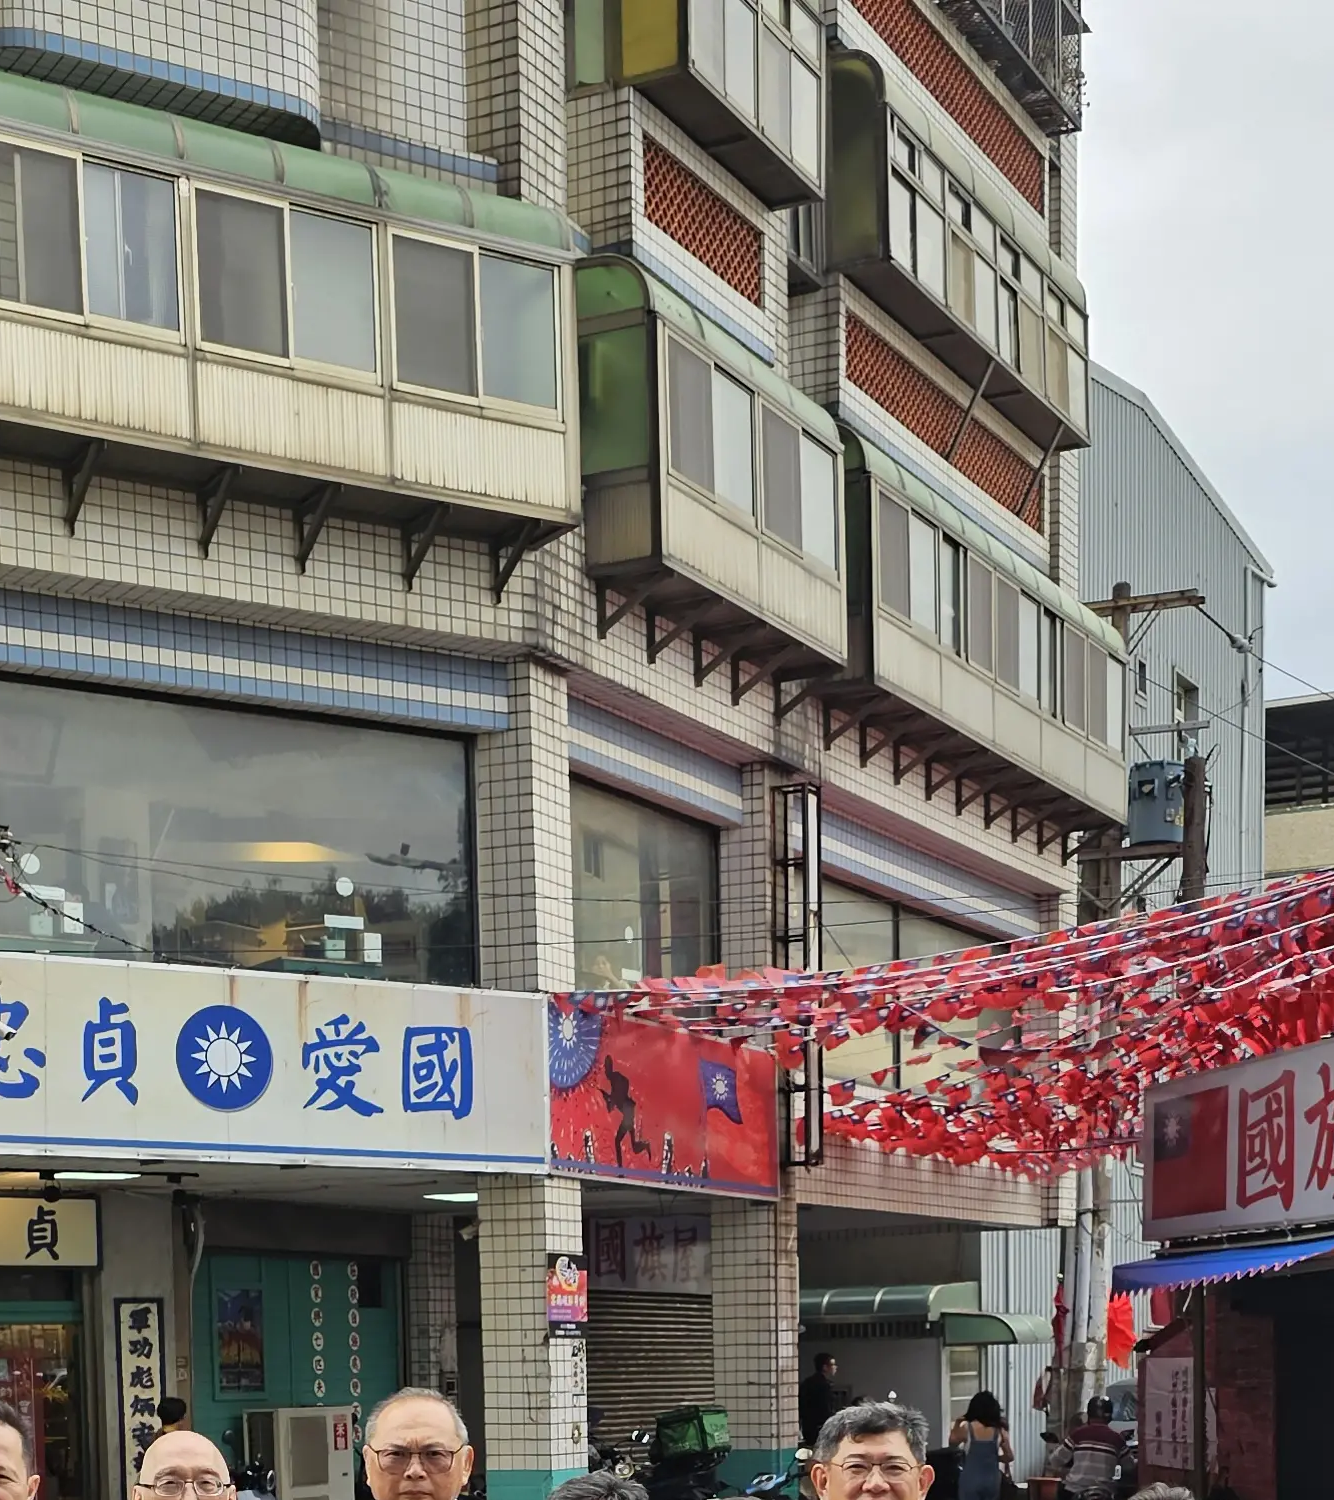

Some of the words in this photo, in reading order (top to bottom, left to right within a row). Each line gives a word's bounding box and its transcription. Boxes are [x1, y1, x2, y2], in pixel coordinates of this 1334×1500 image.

[301, 1014, 474, 1119] 愛國
[25, 1205, 59, 1260] 貞
[595, 1220, 699, 1284] 國旗屋
